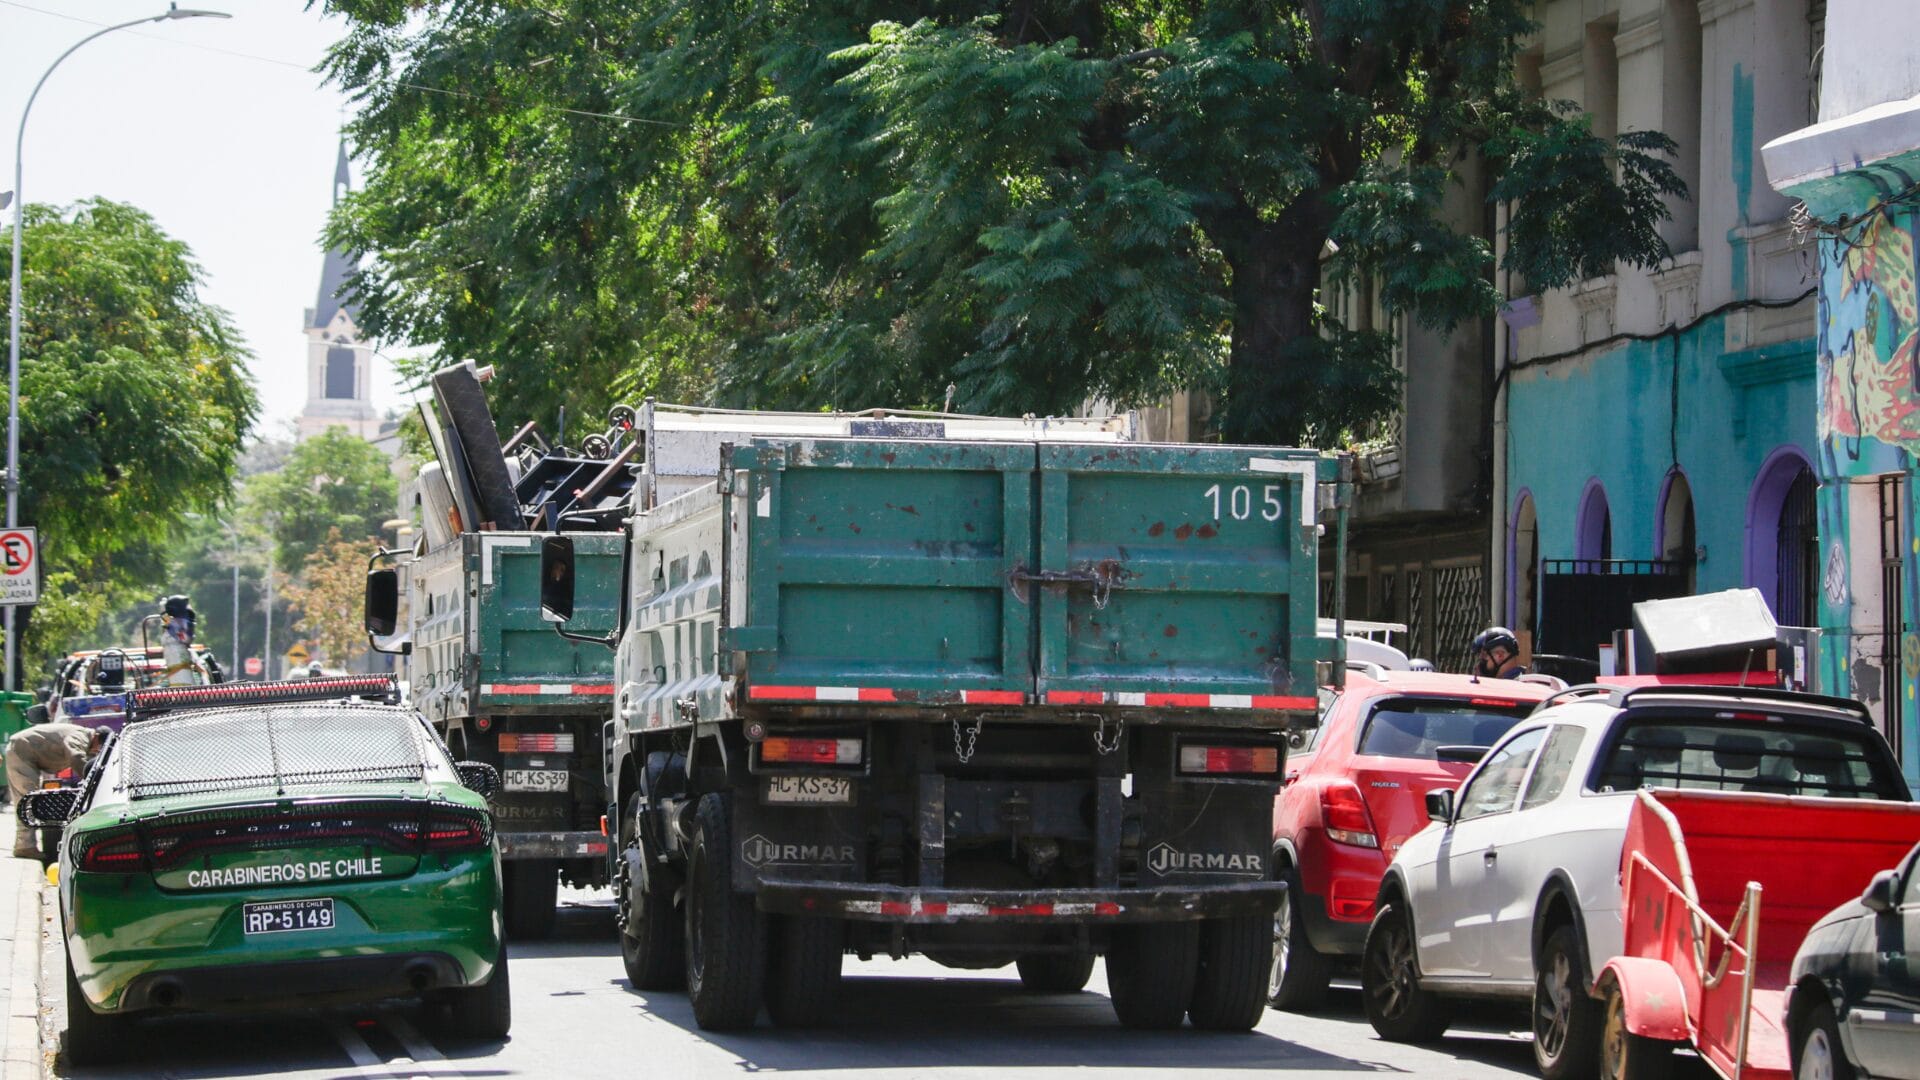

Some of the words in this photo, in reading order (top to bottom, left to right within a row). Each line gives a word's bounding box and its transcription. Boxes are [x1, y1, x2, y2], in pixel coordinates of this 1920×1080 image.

[1204, 484, 1281, 521] 105
[21, 578, 32, 586] LA
[747, 840, 856, 862] JURMAR
[1151, 848, 1262, 870] JURMAR
[188, 863, 306, 888] CARABINEROS
[309, 861, 331, 879] DE
[335, 857, 382, 876] CHILE
[252, 903, 295, 912] CARABINEROS
